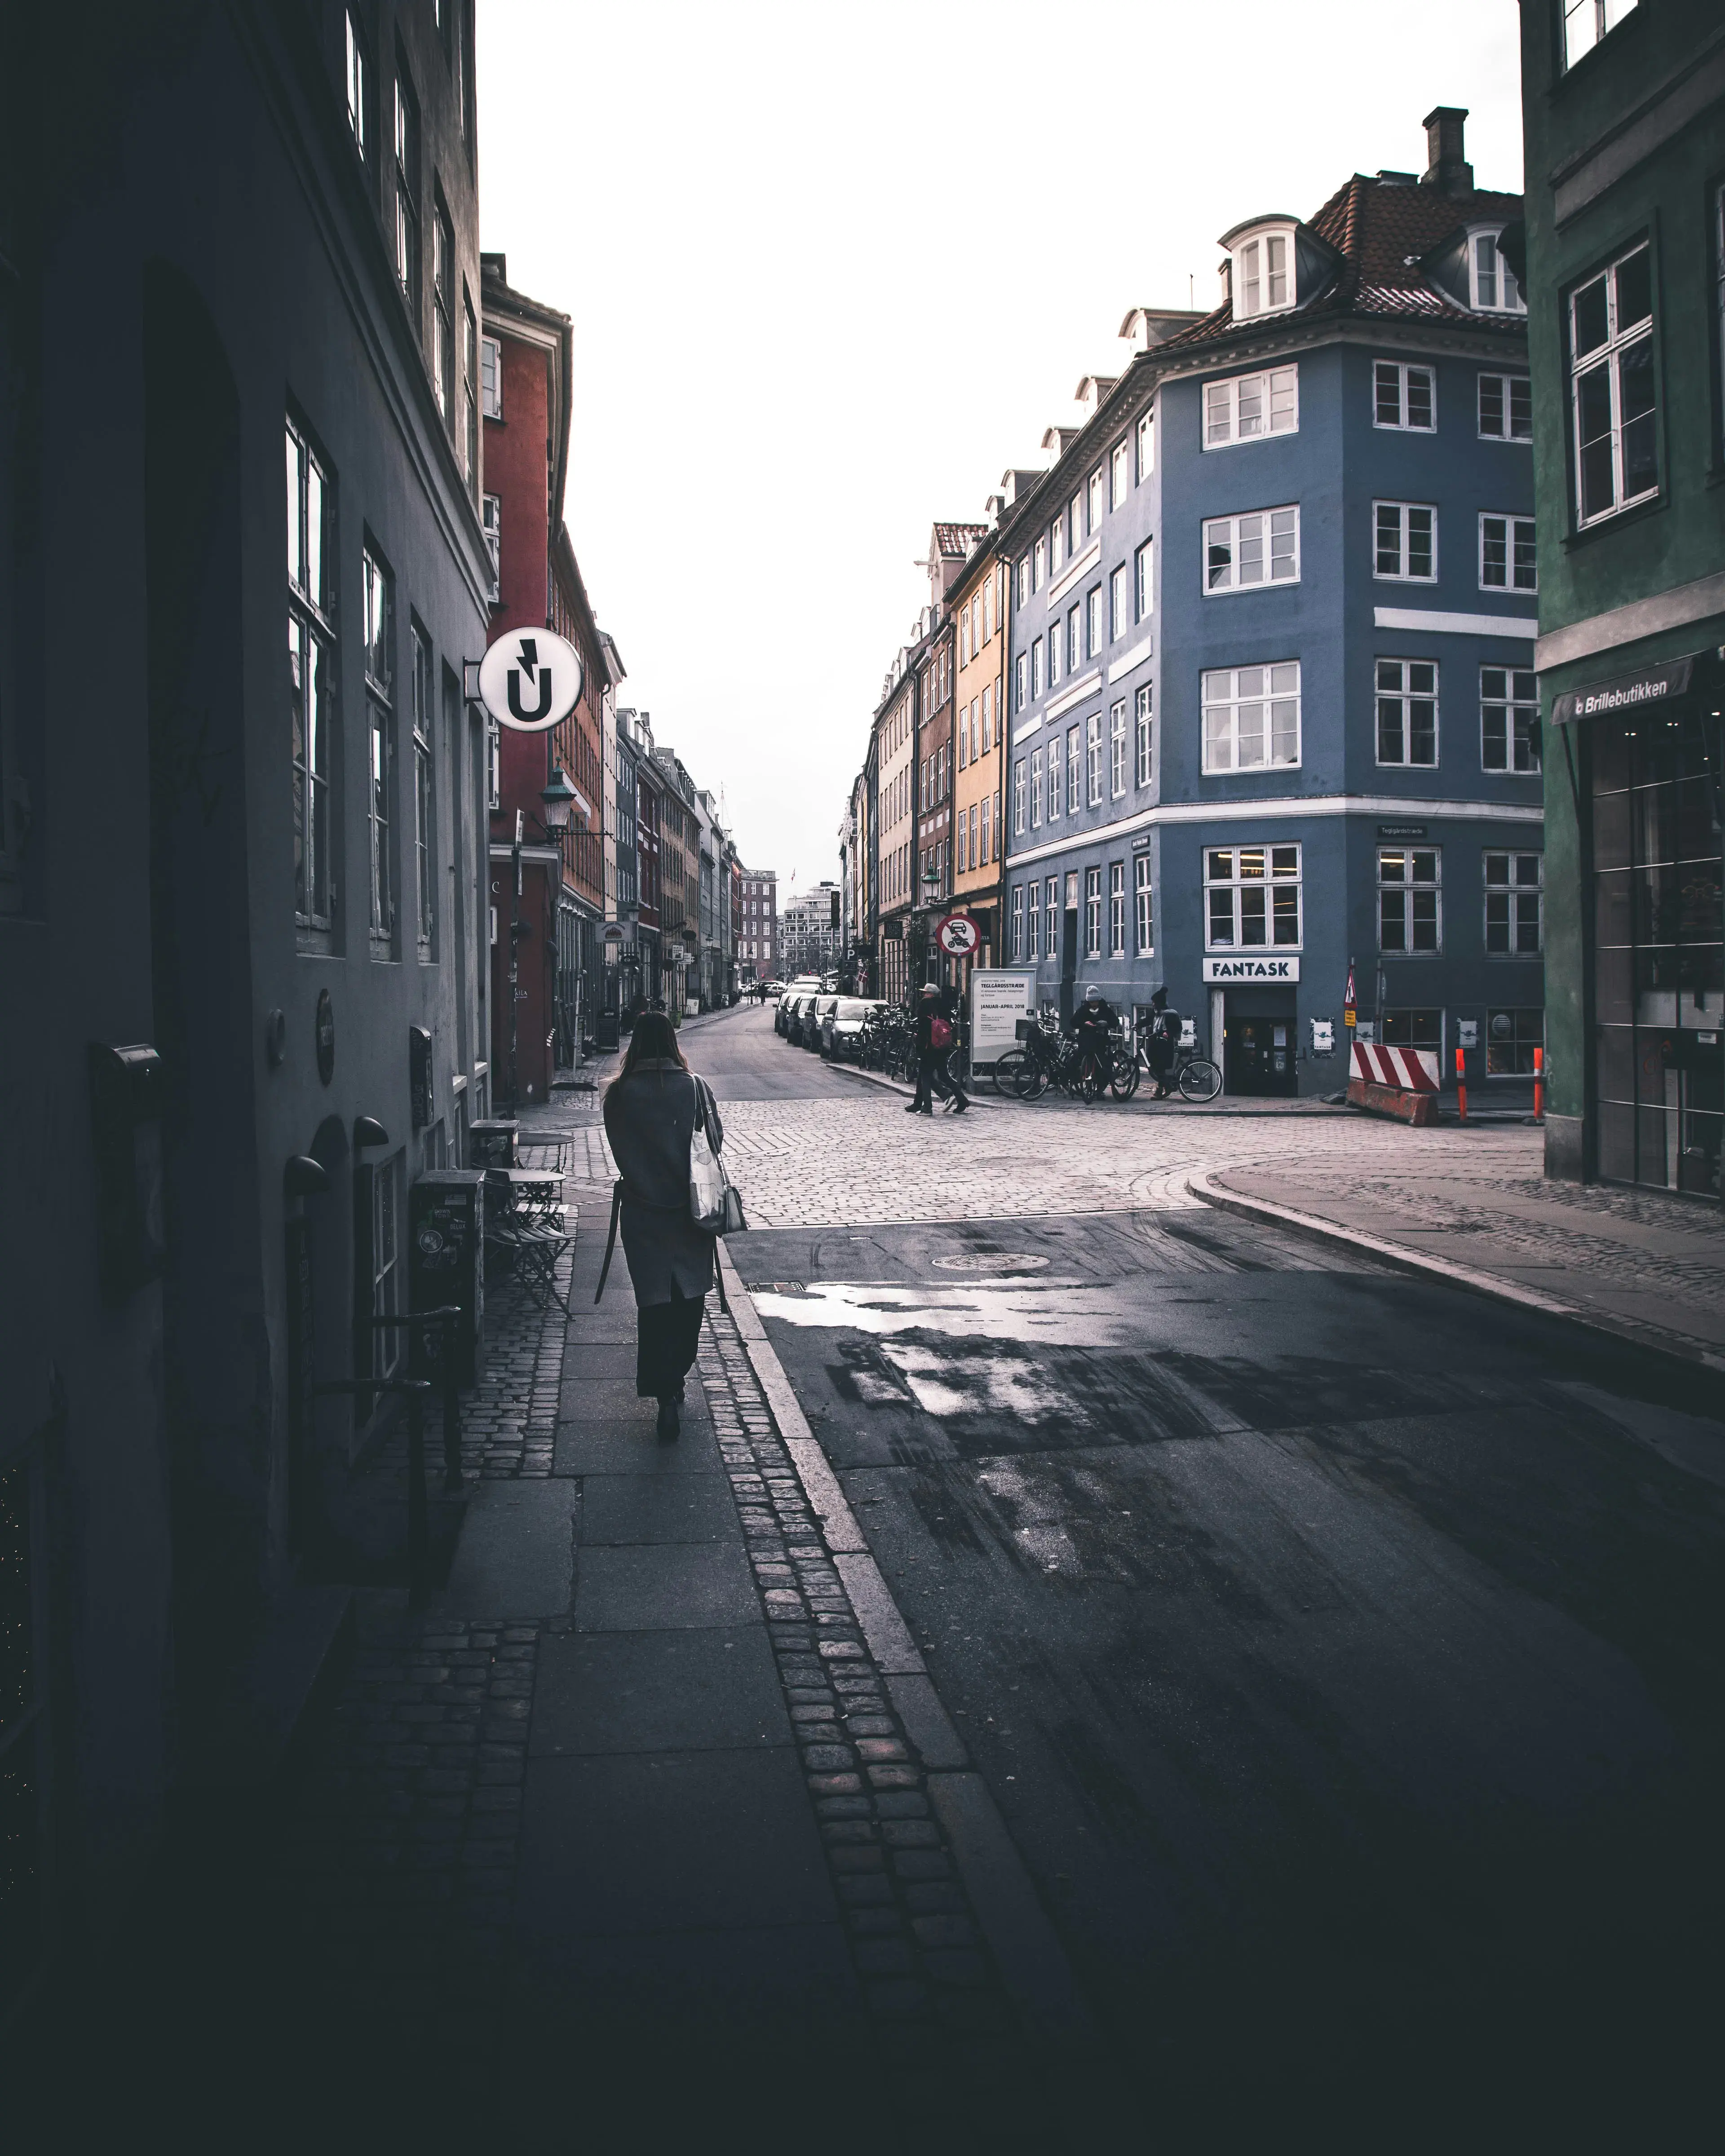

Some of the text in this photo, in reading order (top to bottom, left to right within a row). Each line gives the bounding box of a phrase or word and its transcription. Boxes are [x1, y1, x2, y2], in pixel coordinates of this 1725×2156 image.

[1584, 680, 1667, 713] Brillebutikken
[847, 949, 855, 959] P
[1212, 962, 1289, 976] FANTASK
